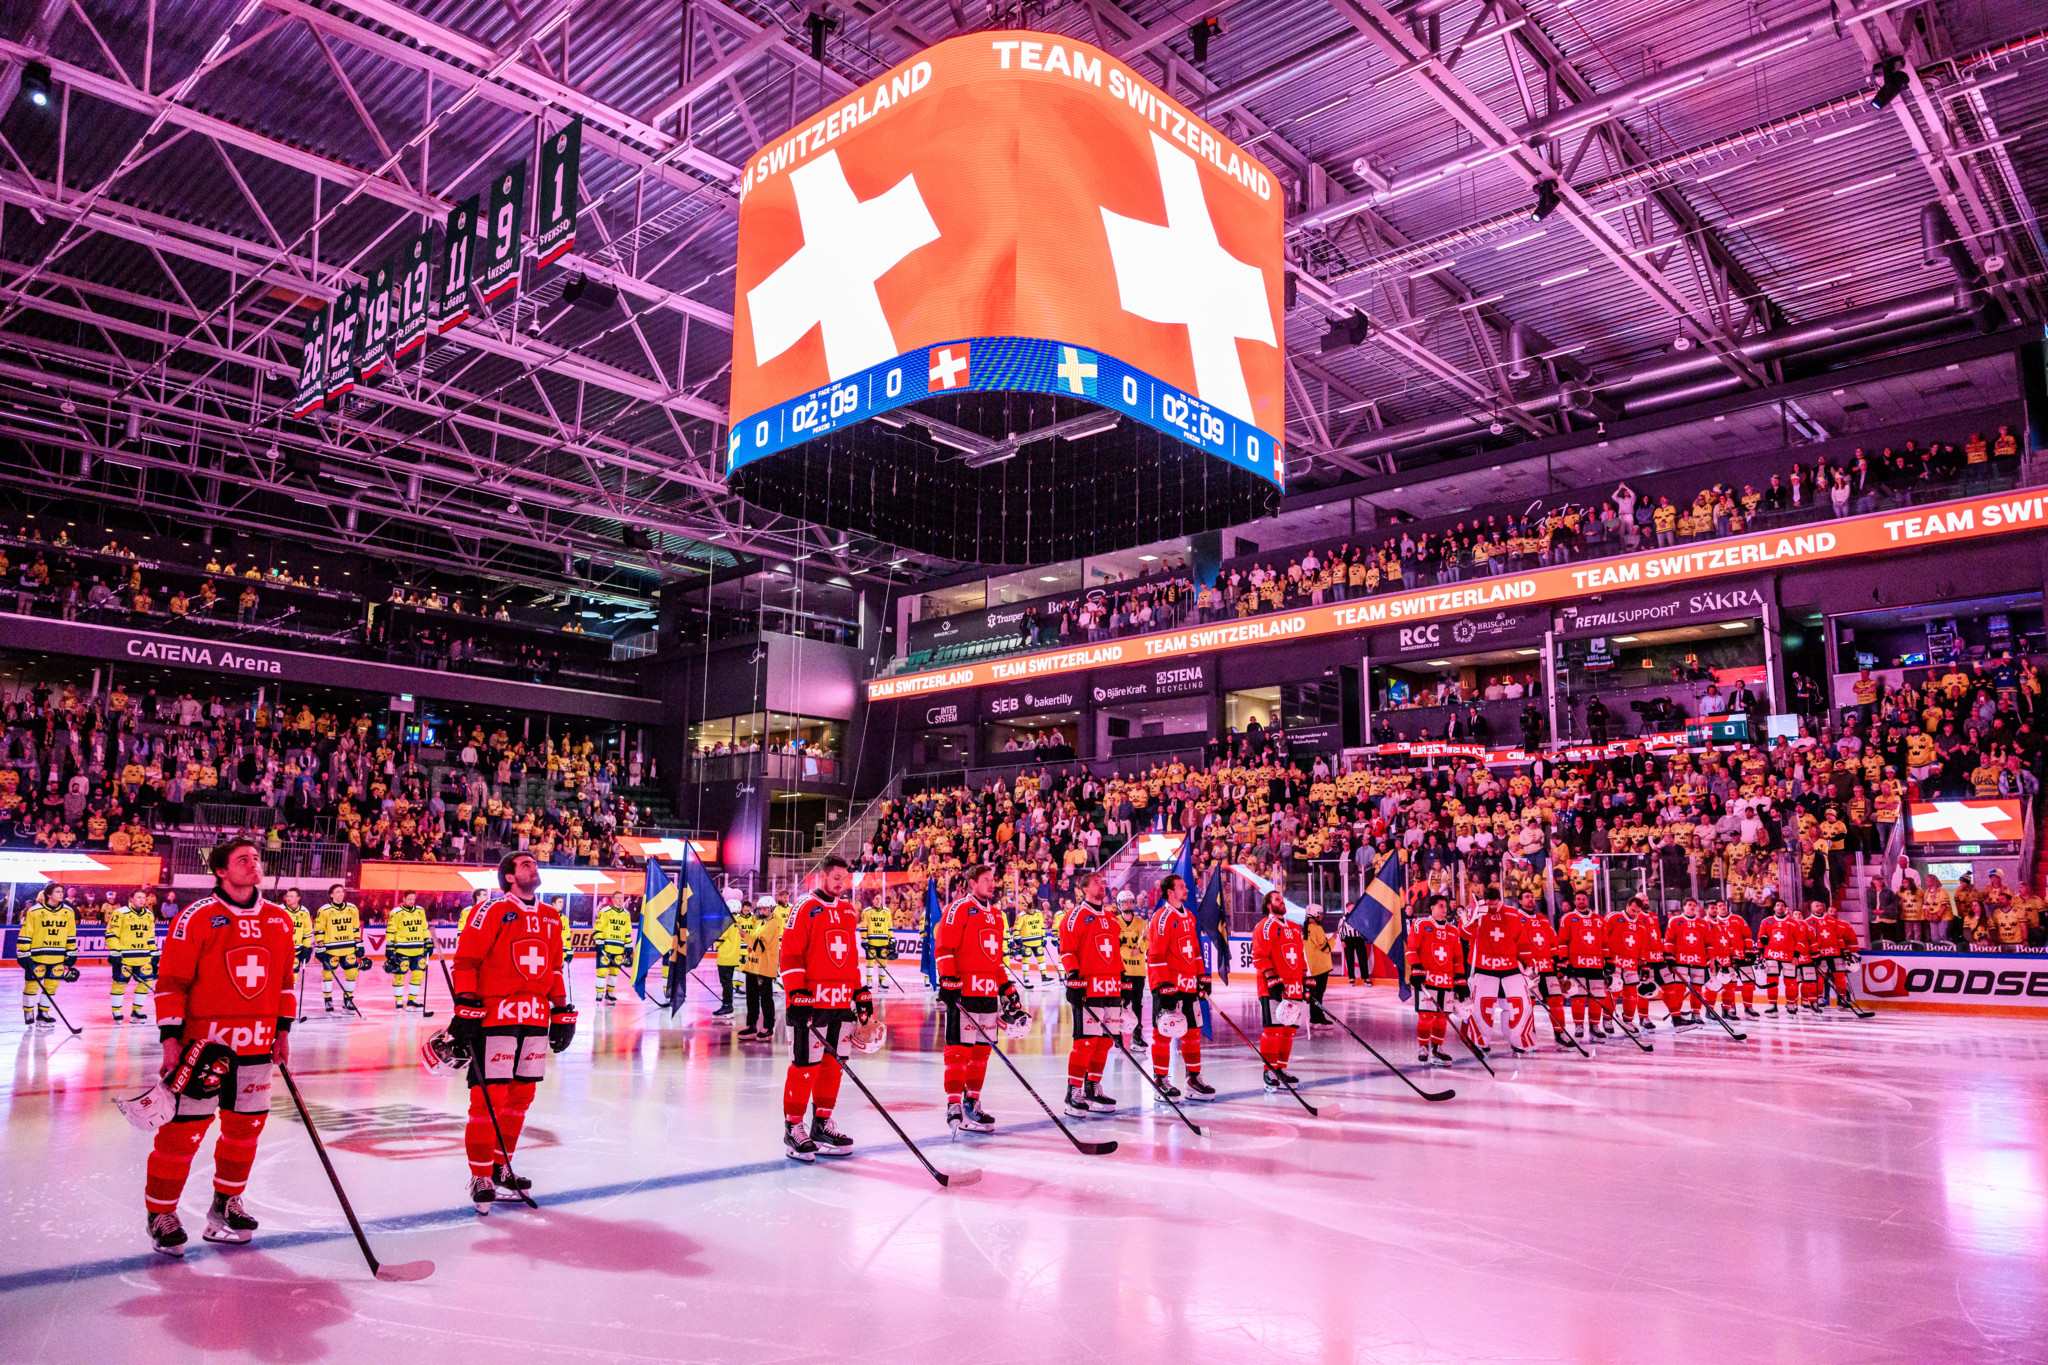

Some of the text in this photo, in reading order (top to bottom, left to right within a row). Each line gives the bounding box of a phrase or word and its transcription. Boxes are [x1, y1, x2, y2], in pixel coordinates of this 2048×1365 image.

[756, 61, 932, 184] SWITZERLAND
[992, 40, 1271, 201] TEAM SWITZERLAND
[552, 162, 564, 223] 1
[495, 202, 513, 260] 9
[539, 218, 571, 246] SVENSSO
[446, 235, 467, 295] 11
[403, 261, 428, 323] 13
[365, 290, 388, 348] 19
[331, 312, 358, 369] 25
[301, 333, 324, 389] 26
[886, 367, 902, 398] 0
[1123, 375, 1137, 406] 0
[792, 384, 858, 433] 02:09
[1163, 394, 1224, 445] 02:09
[756, 420, 769, 447] 0
[1247, 435, 1259, 463] 0
[1883, 509, 1974, 541] TEAM
[1572, 532, 1836, 589] TEAM SWITZERLAND
[1333, 580, 1537, 626] TEAM SWITZERLAND
[1689, 588, 1763, 614] SÄKRA
[1477, 618, 1516, 630] BRISCAPO
[1575, 604, 1675, 629] RETAILSUPPORT
[1144, 617, 1306, 655] TEAM SWITZERLAND
[1400, 624, 1440, 646] RCC
[127, 639, 282, 674] CATENA Arena
[991, 646, 1122, 678] TEAM SWITZERLAND
[896, 670, 974, 693] SWITZERLAND
[1157, 681, 1203, 694] RECYCLING
[1166, 667, 1203, 683] STENA
[1034, 693, 1073, 708] bakertilly
[1107, 684, 1147, 699] Bjäre Kraft
[935, 714, 958, 724] SYSTEM
[940, 705, 957, 715] INTER
[181, 897, 215, 921] TISSOT
[828, 909, 840, 924] 14
[238, 919, 262, 938] 95
[526, 915, 540, 933] 13
[1099, 918, 1109, 929] 18
[1436, 930, 1446, 940] 93
[1531, 919, 1540, 927] 22
[1583, 919, 1592, 927] 90
[1628, 923, 1637, 931] 28
[1882, 942, 1913, 951] Boozt
[1925, 942, 1957, 952] Boozt
[1969, 943, 2002, 953] Boozt
[1904, 968, 2048, 997] ODDSE
[497, 997, 545, 1023] kpt:
[207, 1021, 271, 1052] kpt:
